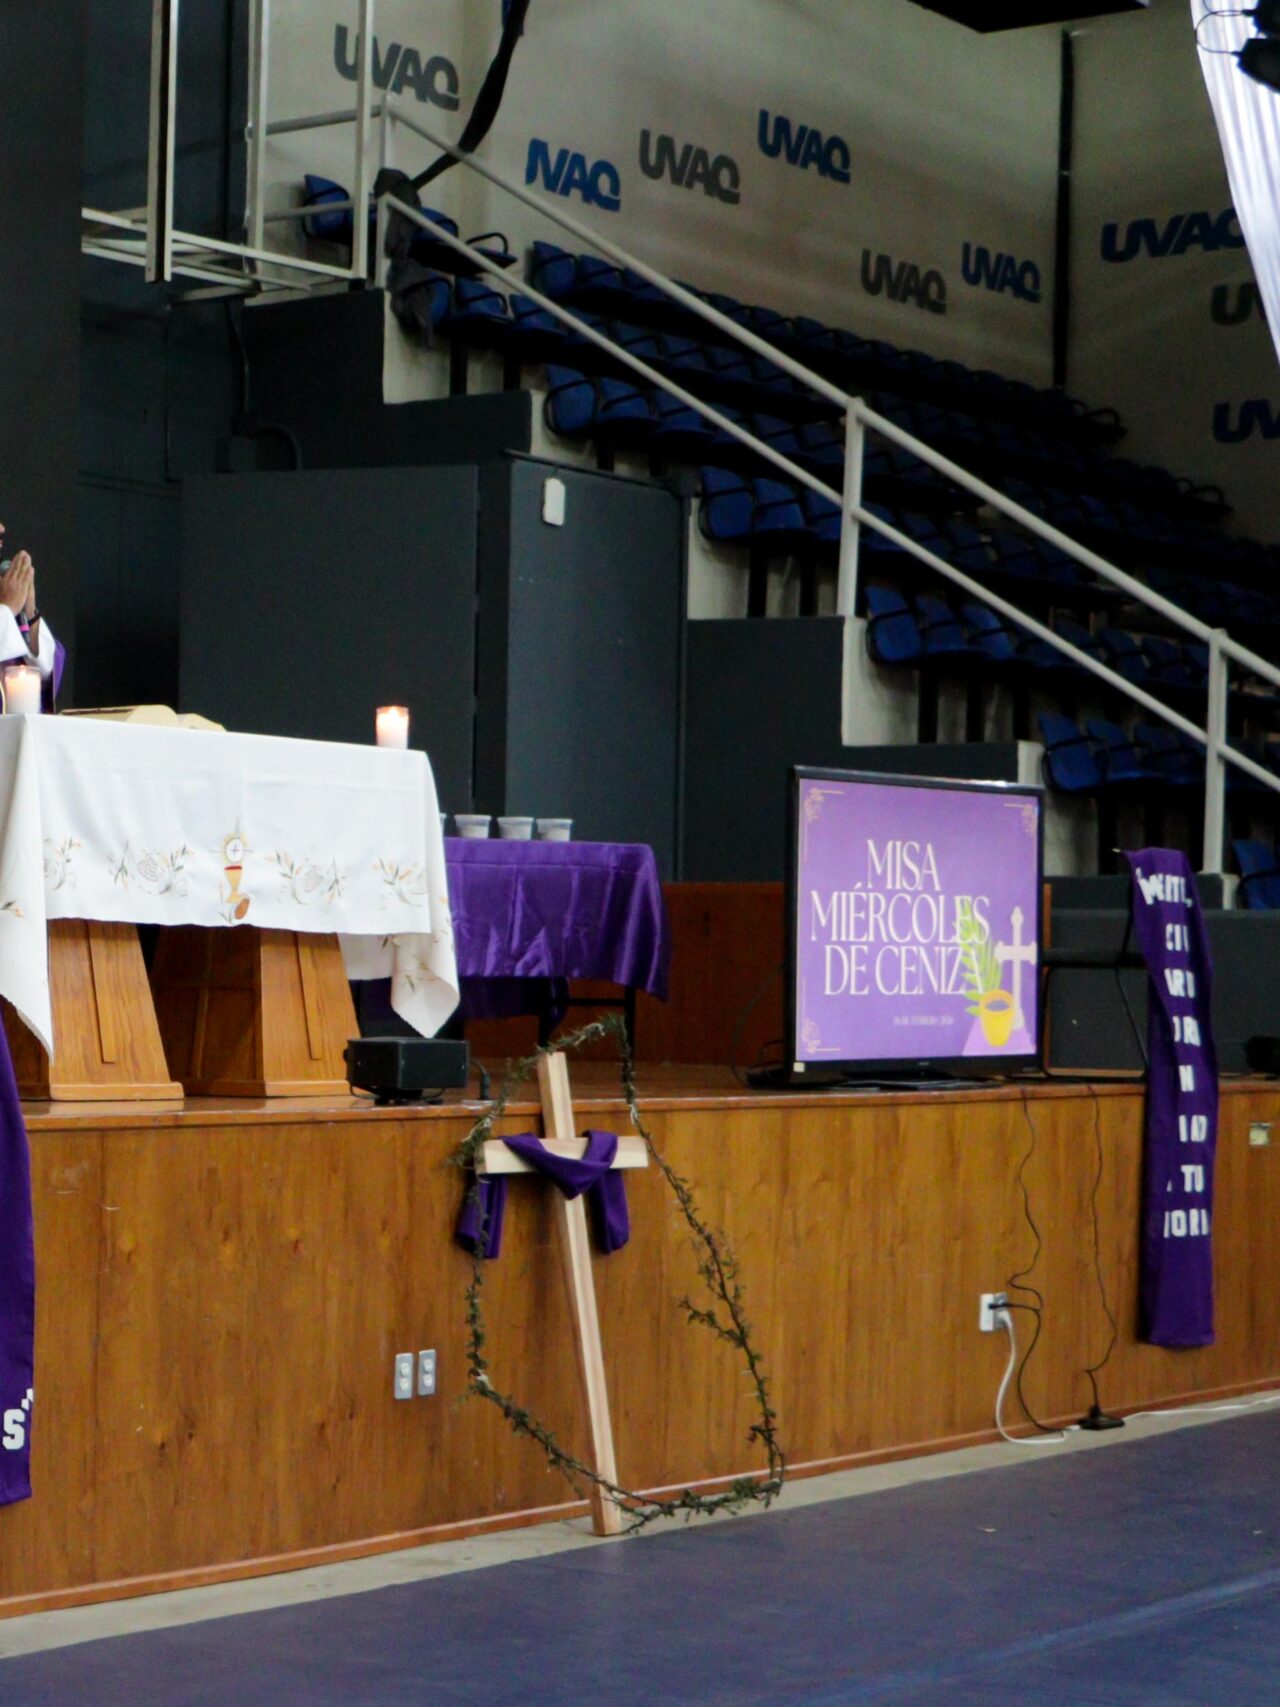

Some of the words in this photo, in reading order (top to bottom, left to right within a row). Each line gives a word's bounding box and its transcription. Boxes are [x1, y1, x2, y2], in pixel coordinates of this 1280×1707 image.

[639, 128, 741, 205] UVAQ
[758, 108, 851, 184] UVAQ
[860, 248, 947, 315] UVAQ
[962, 241, 1041, 304] UVAQ
[867, 839, 941, 891] MISA
[811, 881, 990, 944] MIÉRCOLES
[824, 944, 869, 995] DE
[875, 945, 984, 996] CENIZA
